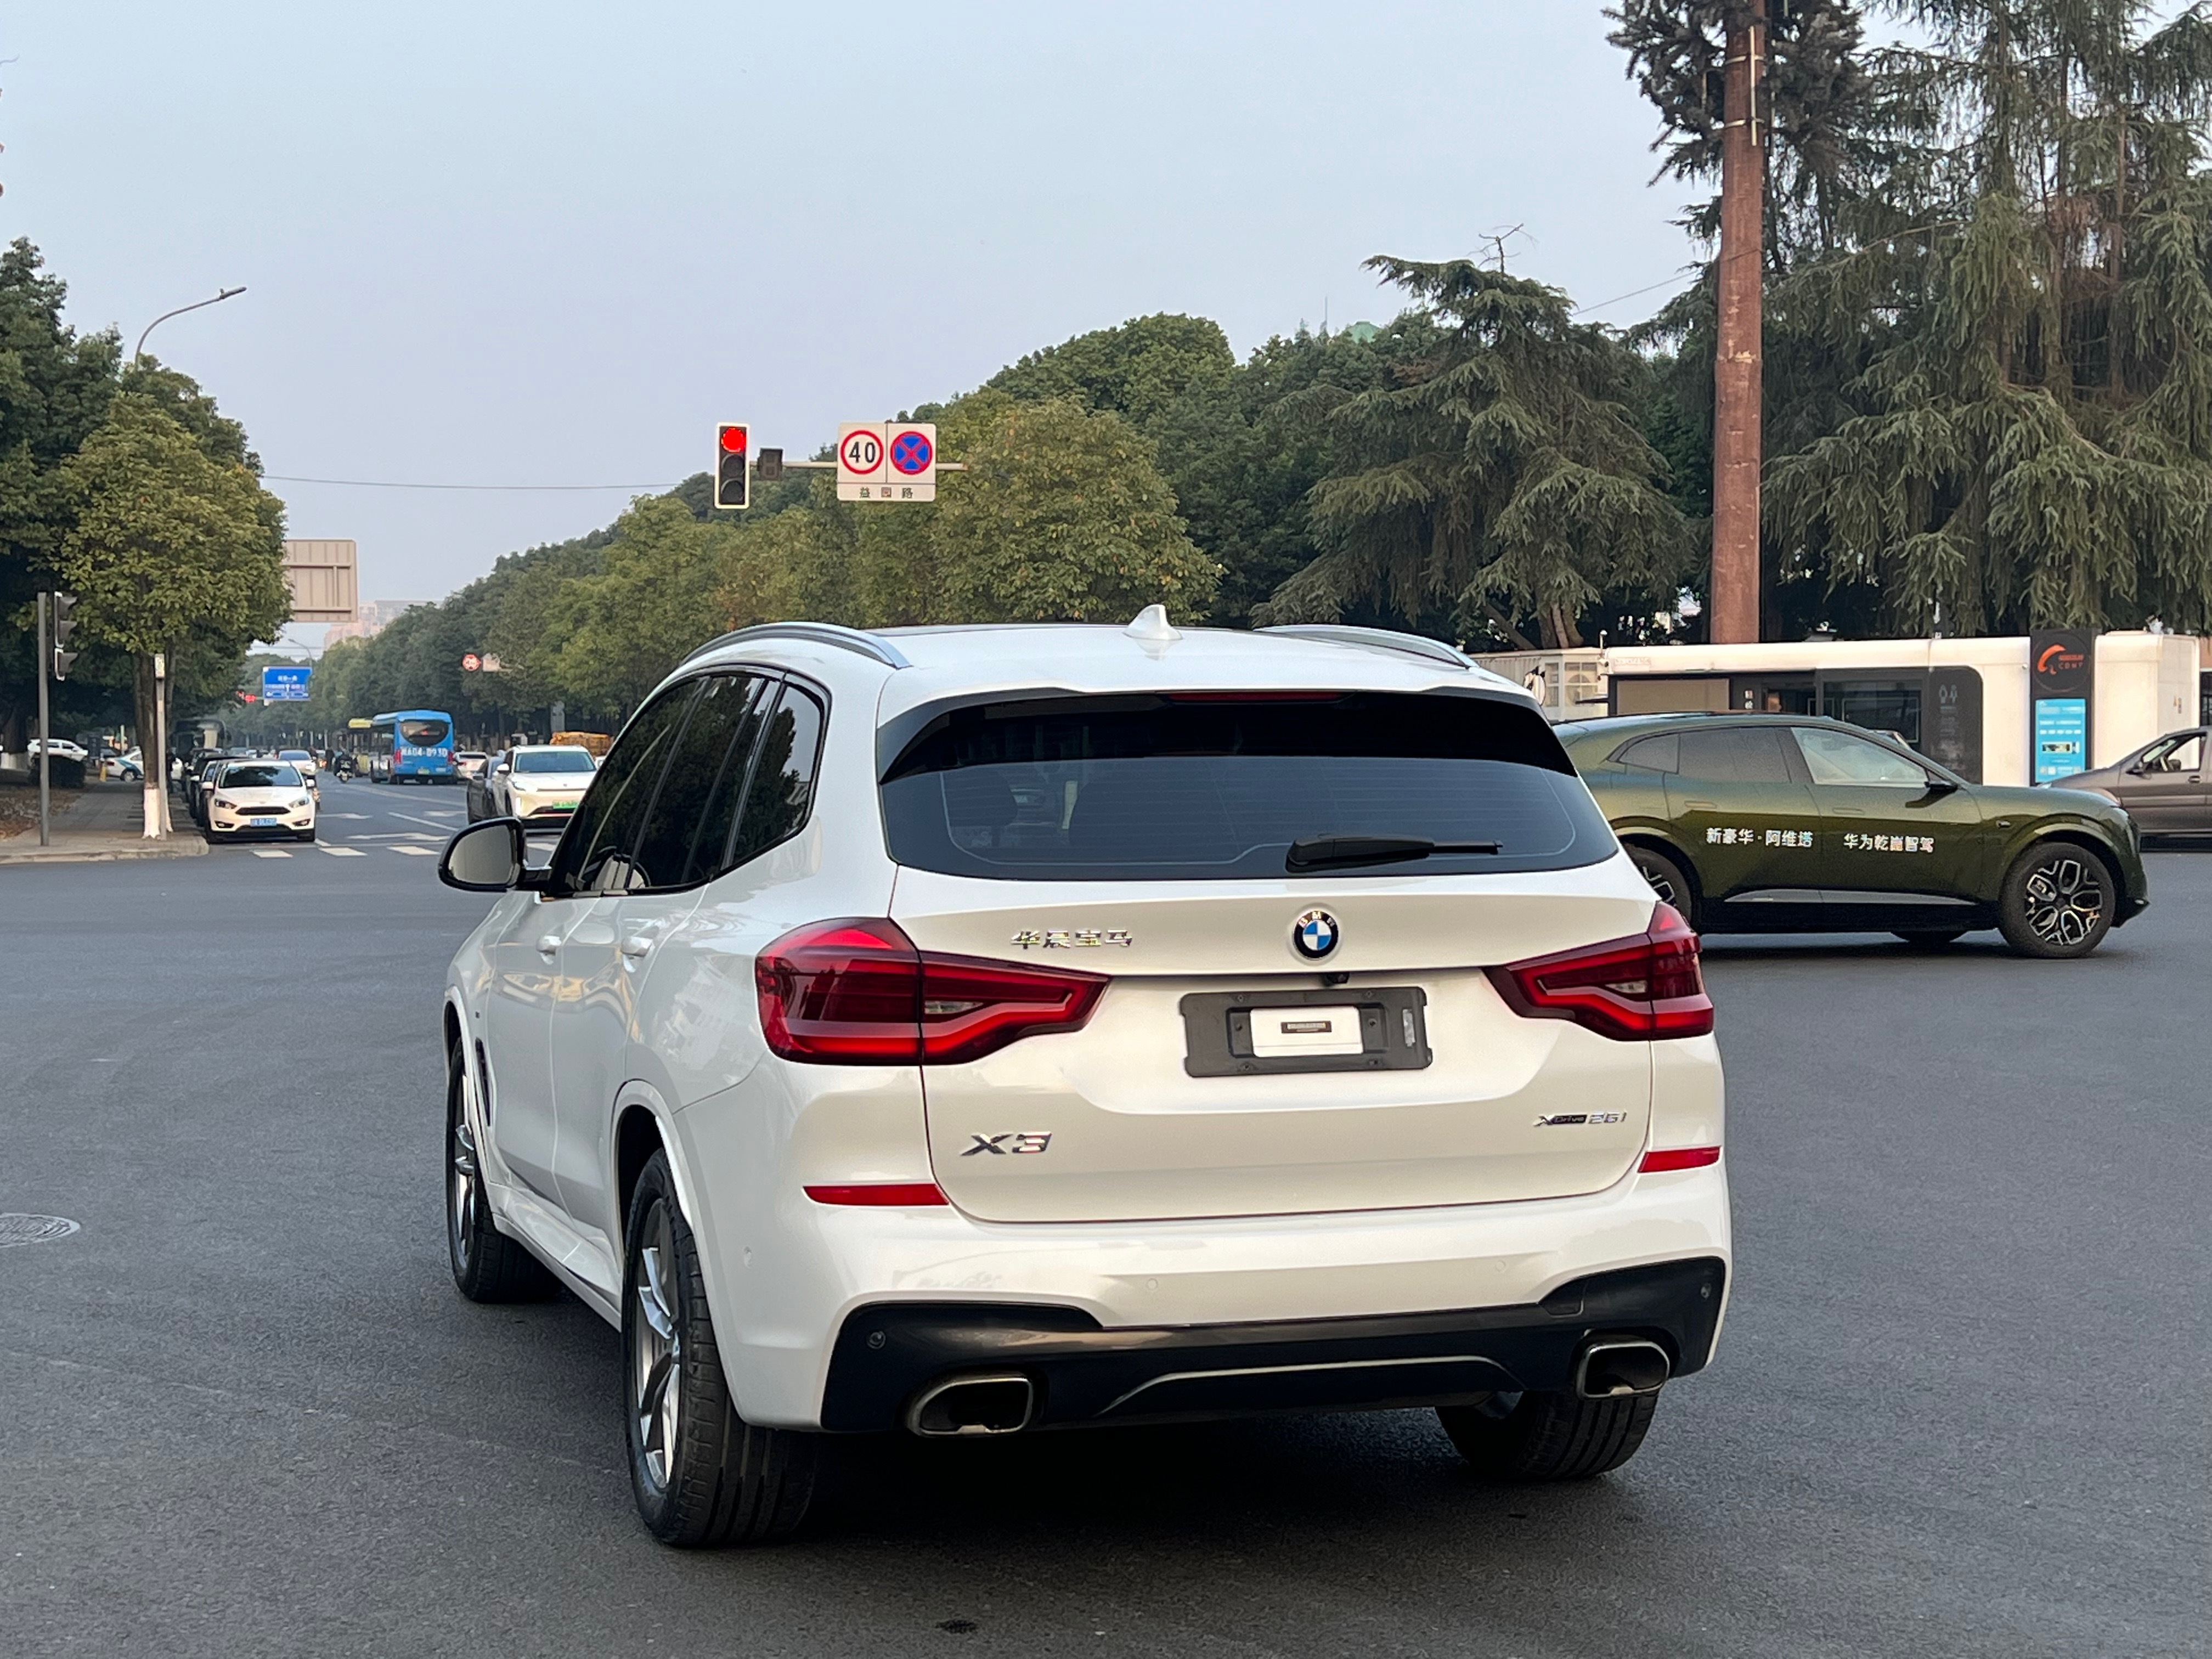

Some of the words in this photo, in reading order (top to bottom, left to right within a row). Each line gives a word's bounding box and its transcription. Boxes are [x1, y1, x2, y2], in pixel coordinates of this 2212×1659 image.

[849, 441, 876, 463] 40
[1011, 928, 1133, 950] 华晨宝马
[960, 1131, 1052, 1156] X3
